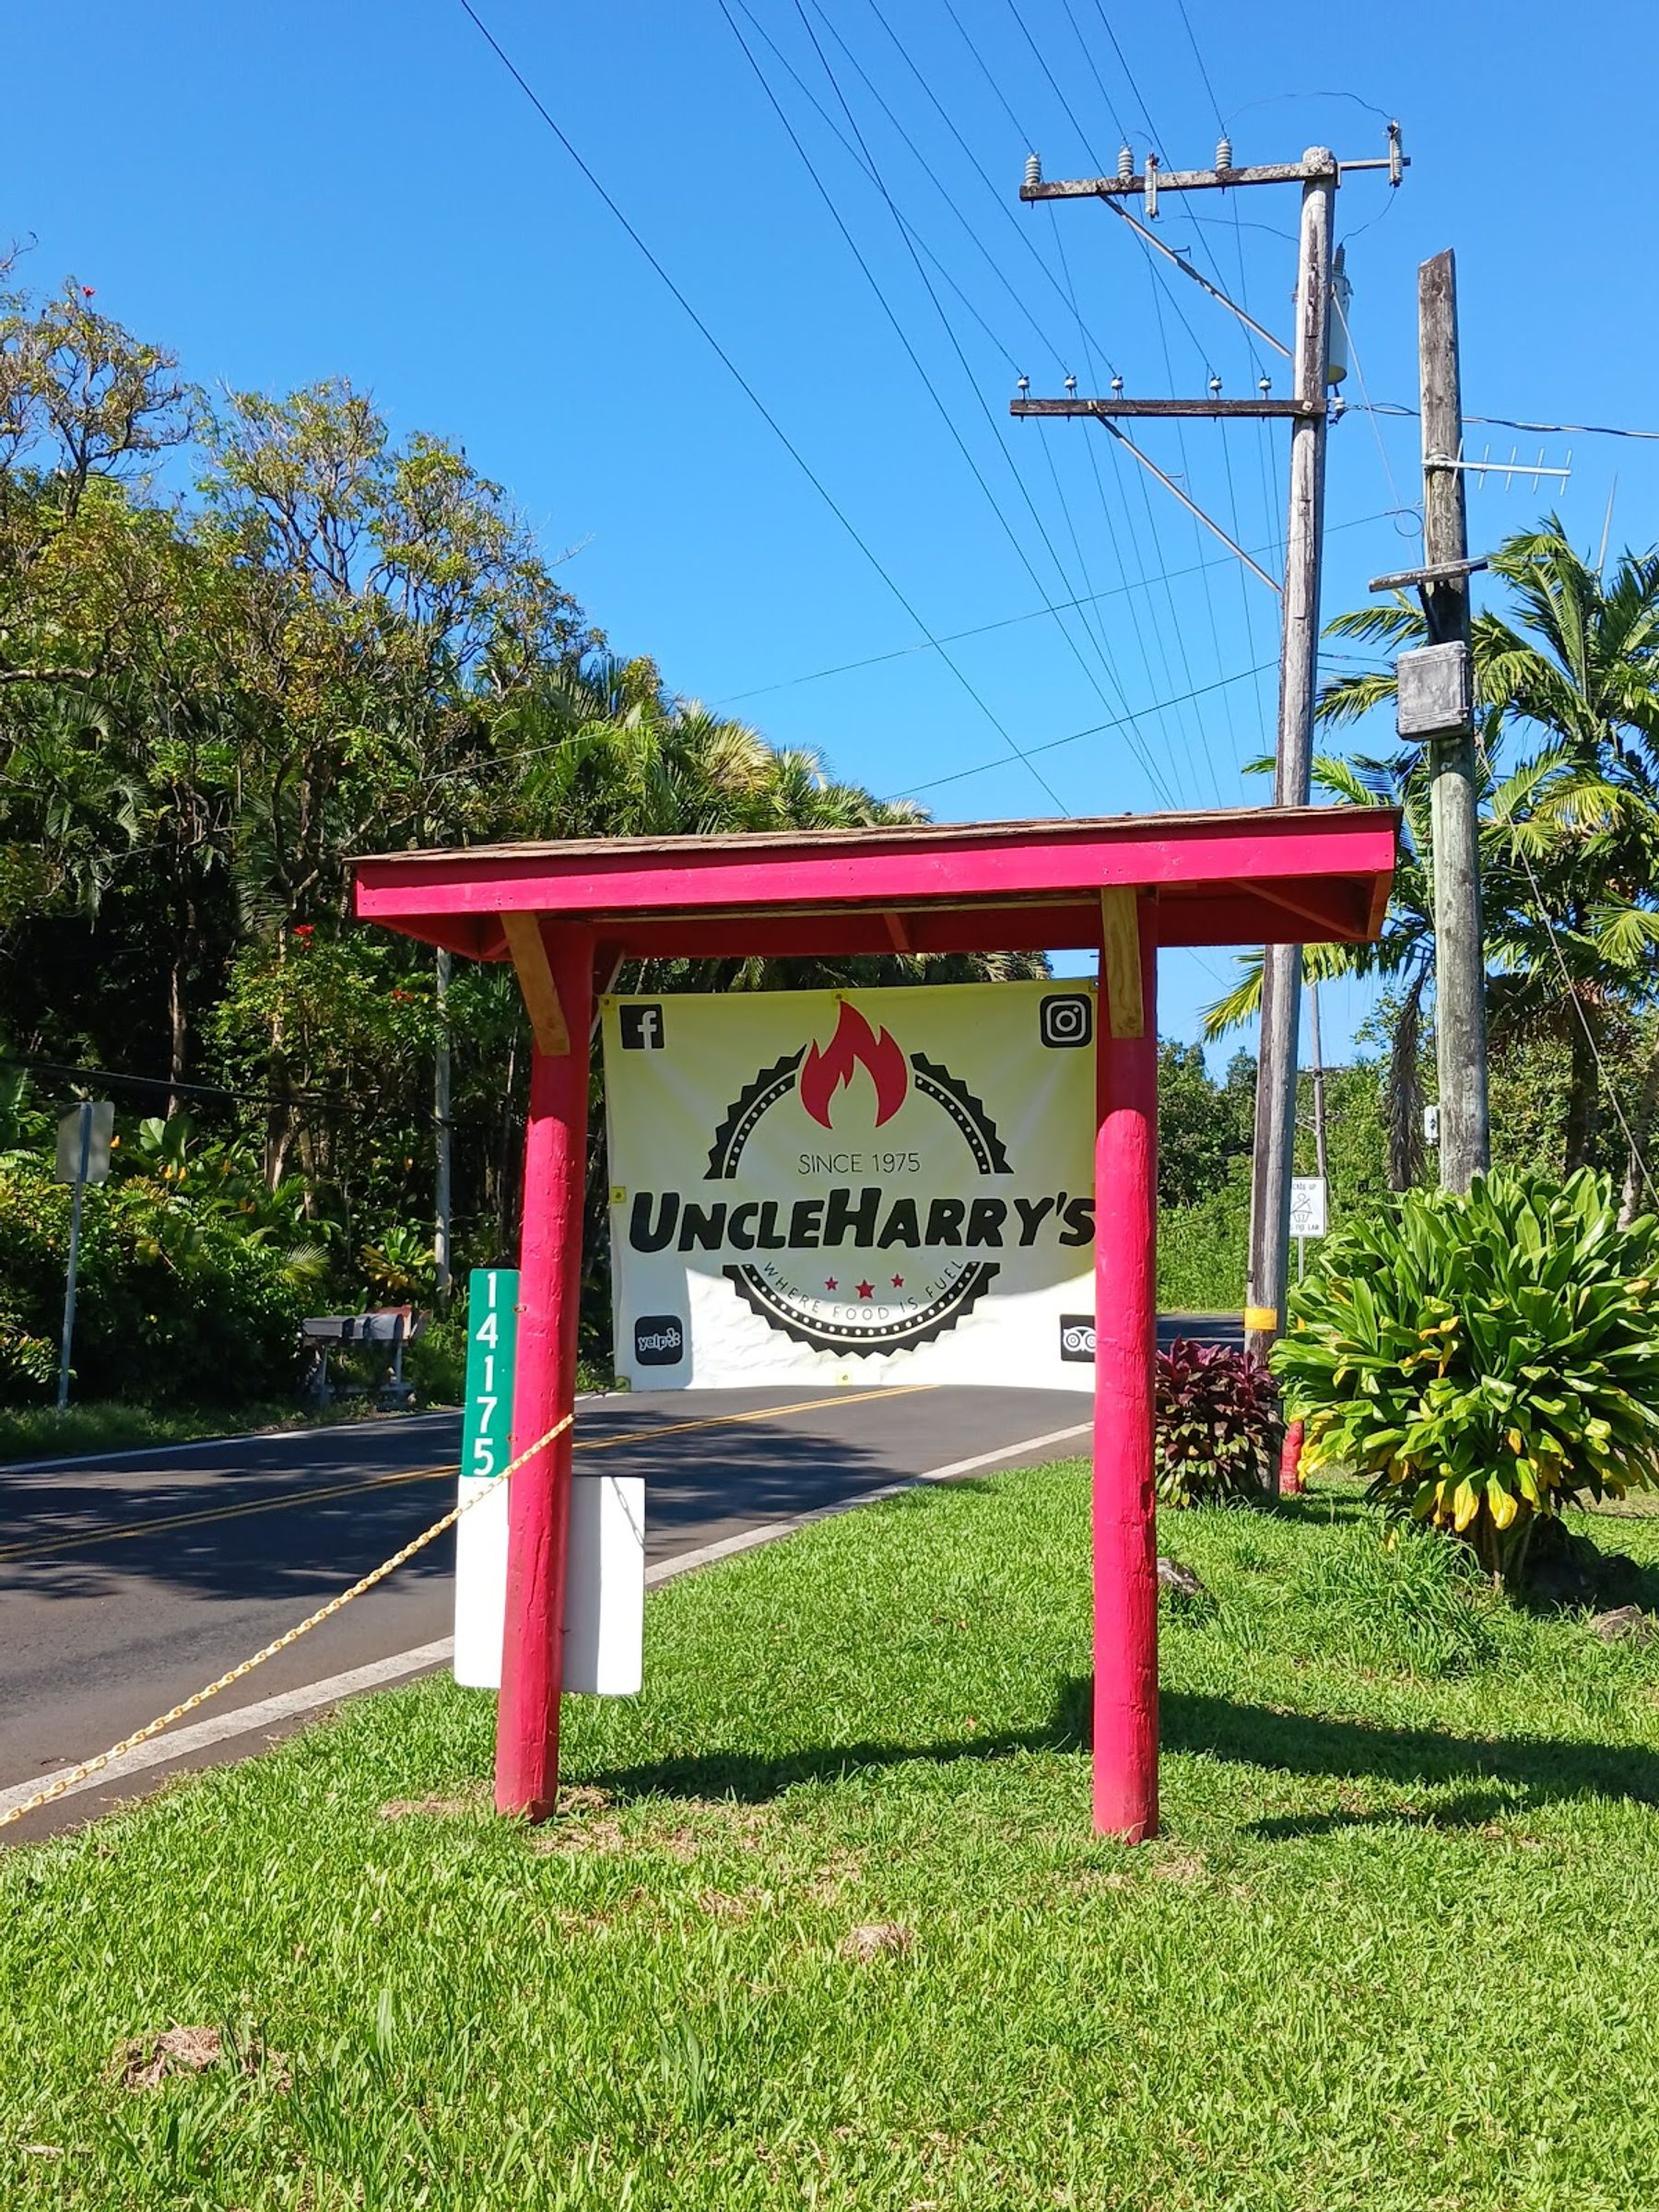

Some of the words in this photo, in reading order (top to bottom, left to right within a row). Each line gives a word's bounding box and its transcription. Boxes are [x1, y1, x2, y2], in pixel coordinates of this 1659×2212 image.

[797, 1154, 863, 1174] SINCE
[872, 1153, 920, 1172] 1975
[763, 1262, 820, 1312] WHERE
[832, 1306, 888, 1321] FOOD
[900, 1297, 920, 1312] IS
[925, 1260, 963, 1299] FUEL
[473, 1272, 499, 1477] 14175
